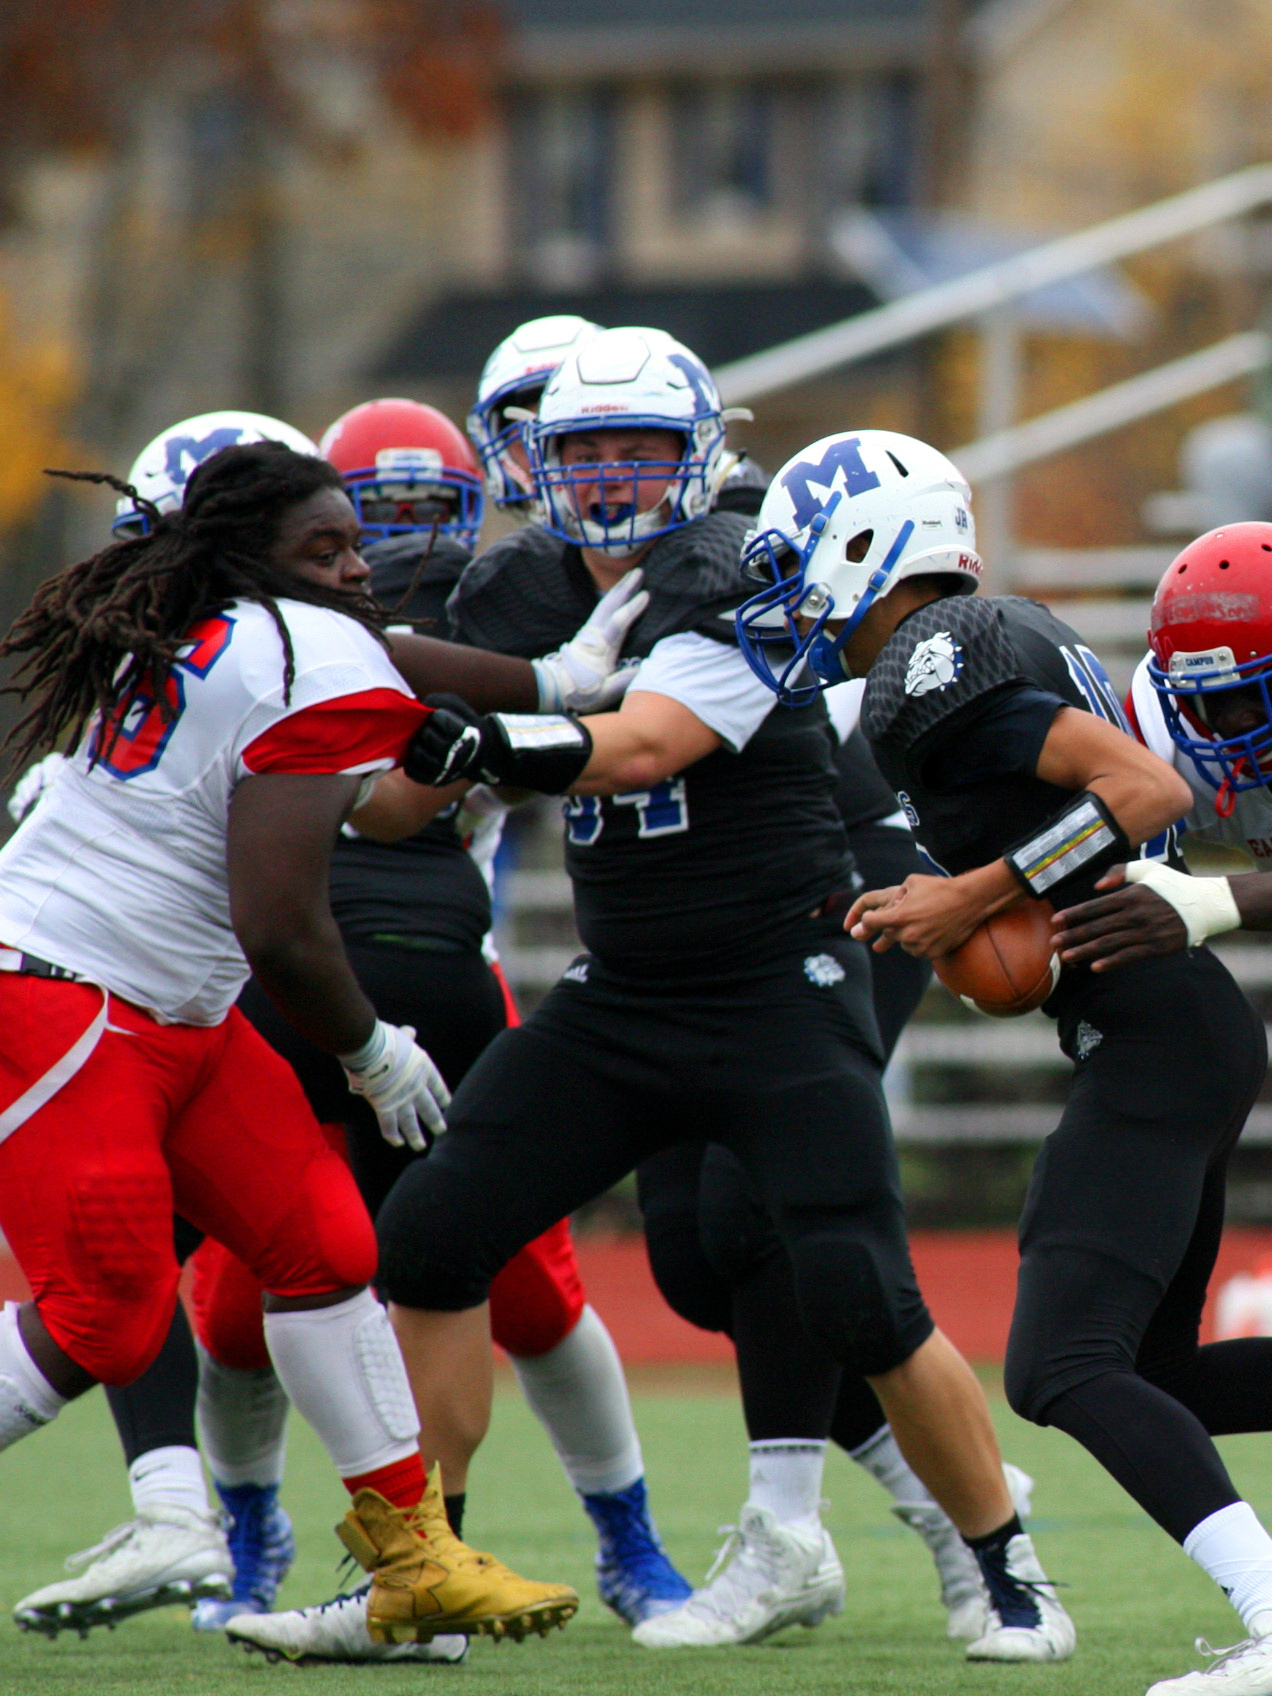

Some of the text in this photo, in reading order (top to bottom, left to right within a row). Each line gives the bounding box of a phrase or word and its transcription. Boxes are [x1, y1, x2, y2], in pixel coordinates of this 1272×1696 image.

[165, 427, 245, 485] M
[779, 437, 882, 532] M
[1185, 656, 1214, 667] CAMPUS
